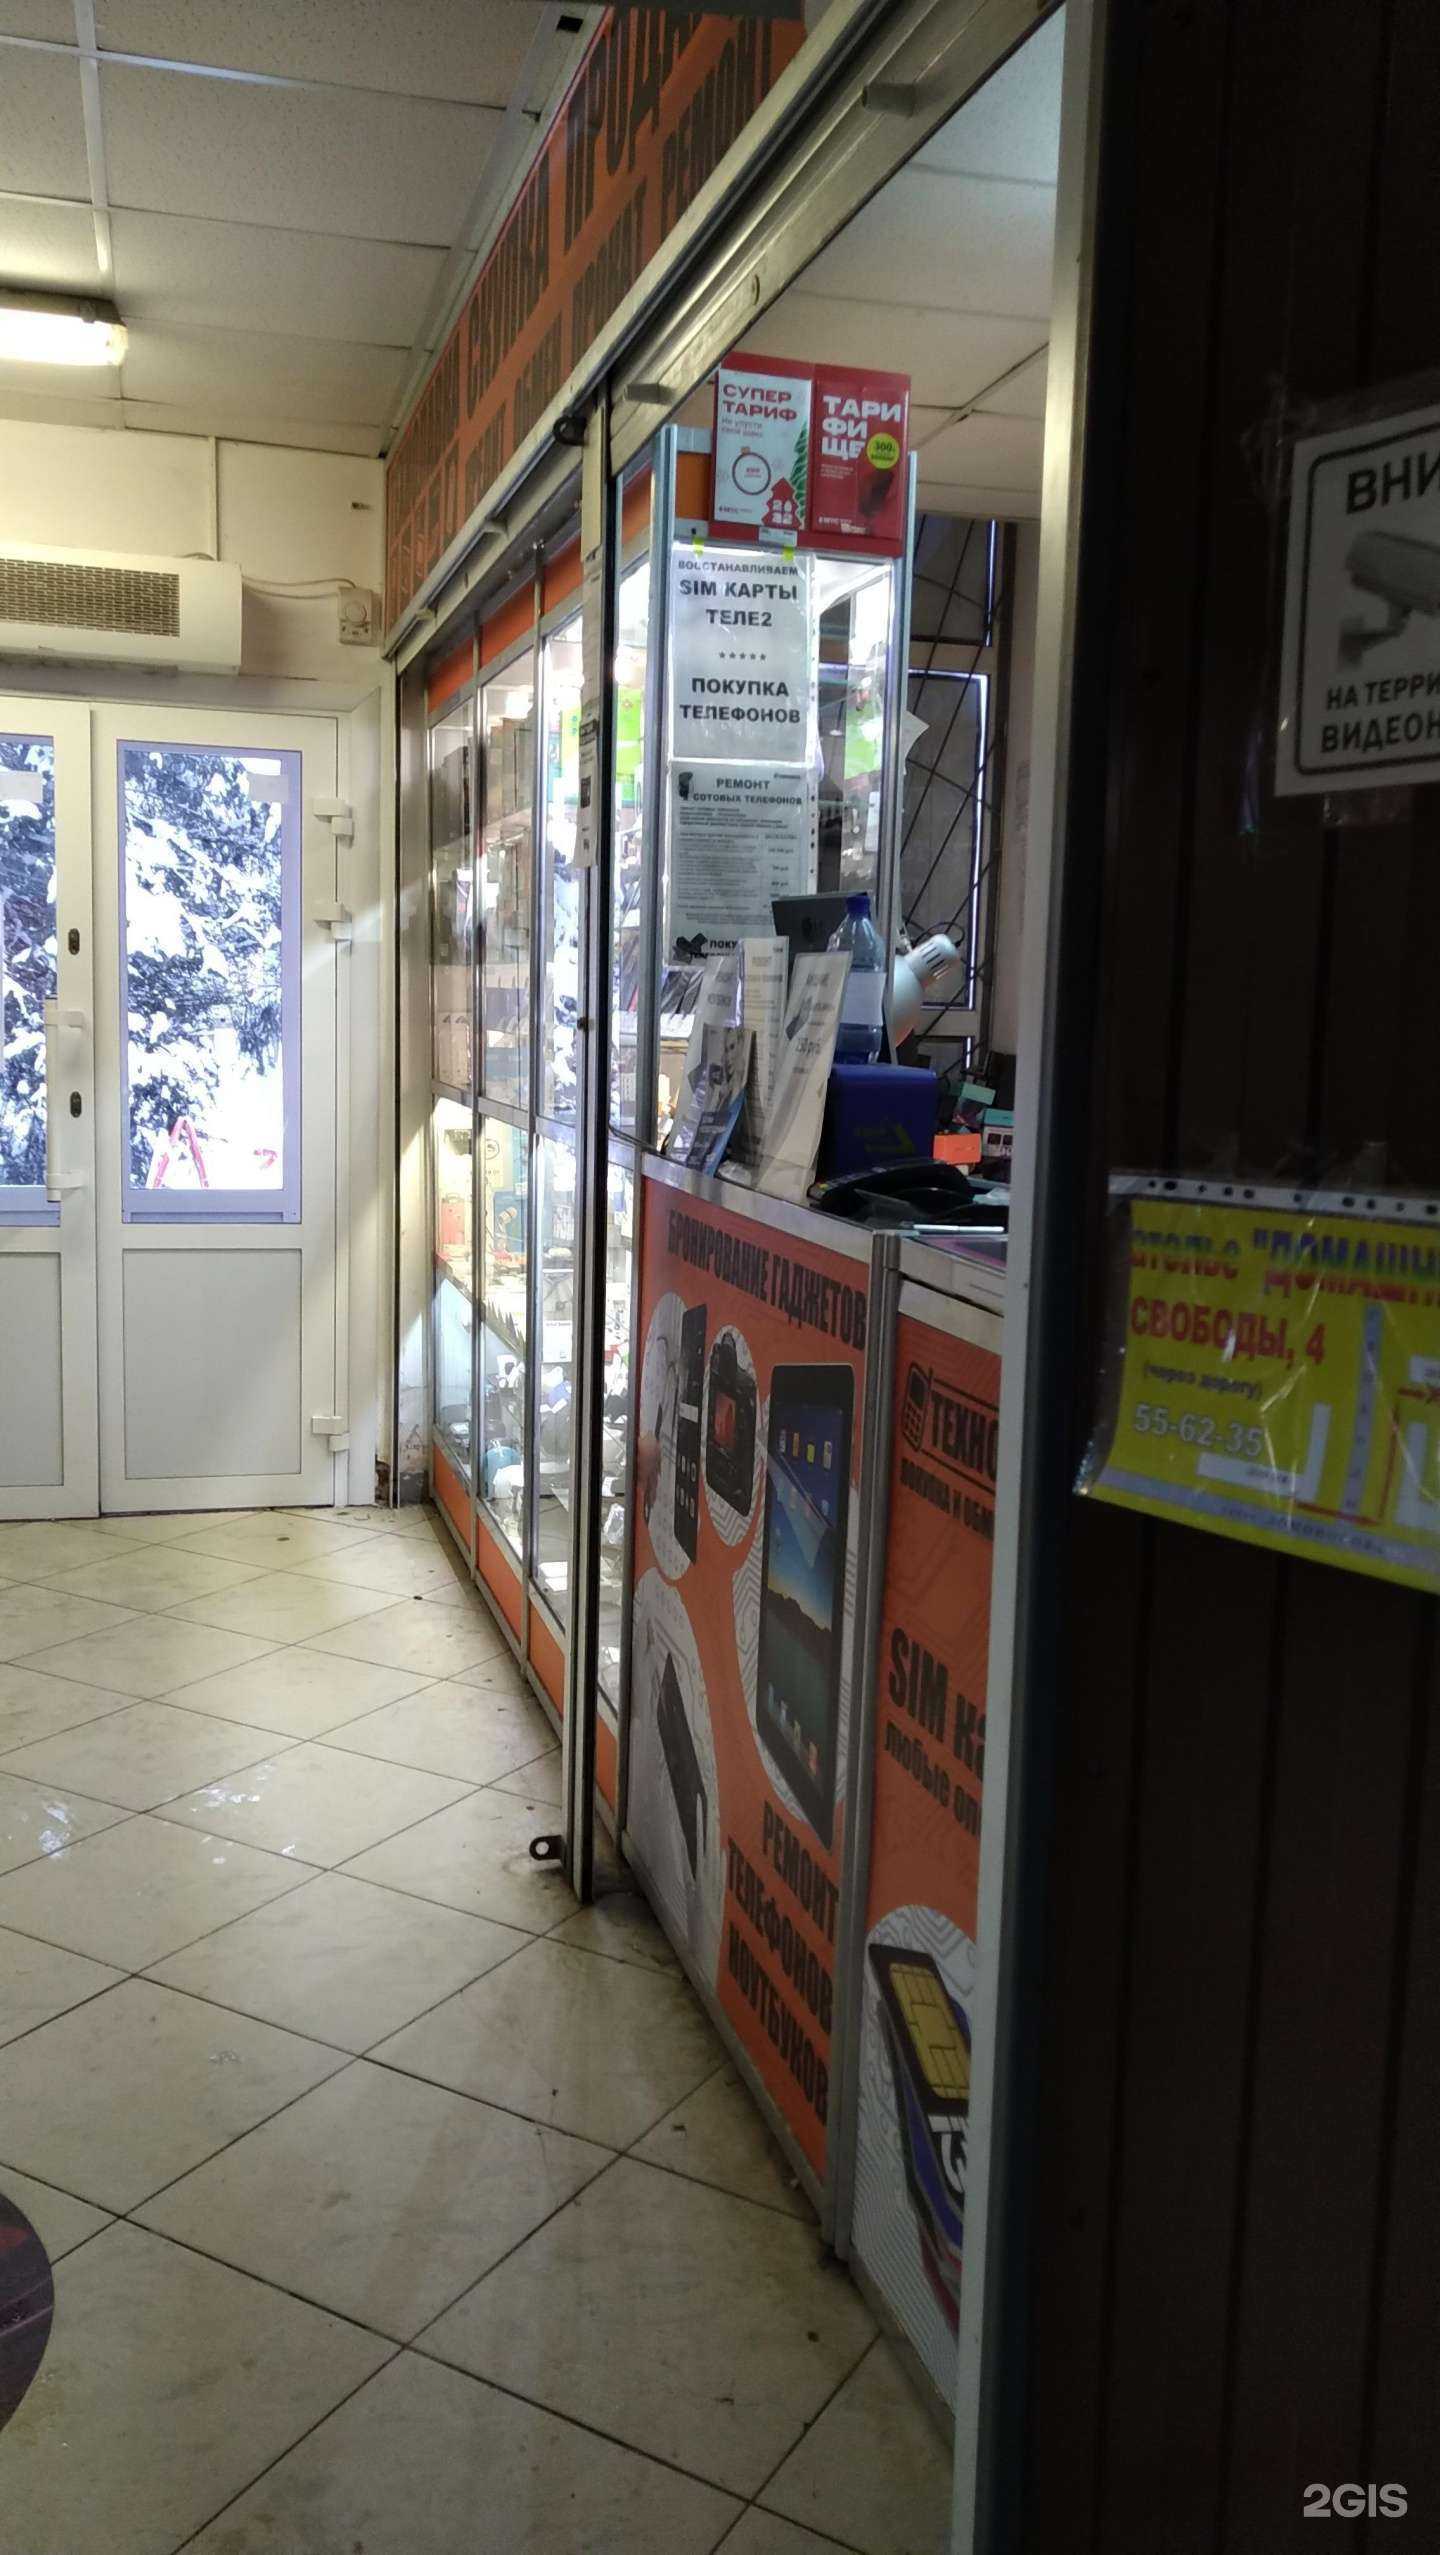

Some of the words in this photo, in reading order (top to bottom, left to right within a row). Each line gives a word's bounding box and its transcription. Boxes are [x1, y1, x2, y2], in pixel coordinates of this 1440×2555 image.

[722, 384, 792, 404] СУПЕР
[722, 401, 797, 421] ТАРИФ
[822, 395, 902, 422] ТАРИ
[822, 417, 868, 439] ФИ
[821, 436, 866, 461] ЩЕ
[678, 560, 799, 575] ВОССТАНАВЛИВАЕМ
[680, 579, 717, 597] SIM
[724, 582, 798, 600] КАРТЫ
[705, 609, 773, 627] ТЕЛЕ2
[691, 677, 789, 697] ПОКУПКА
[1326, 685, 1359, 711] НА
[679, 704, 800, 723] ТЕЛЕФОНОВ
[716, 778, 770, 790] РЕМОНТ
[693, 792, 742, 803] СОТОВЫХ
[744, 795, 803, 805] ТЕЛЕФОНОВ
[667, 1209, 768, 1301] БРОНИРОВАНИЕ
[772, 1254, 868, 1351] ГАДЖЕТОВ
[1130, 1296, 1295, 1369] СВОБОДЫ,
[1306, 1323, 1326, 1365] 4
[1133, 1404, 1264, 1457] 55-62-35
[889, 1627, 949, 1743] SIM
[884, 1719, 950, 1807] любые
[762, 1800, 839, 1944] РЕМОНТ
[726, 1835, 834, 2036] ТЕЛЕФОНОВ
[726, 1920, 830, 2127] НОУТБУКОВ
